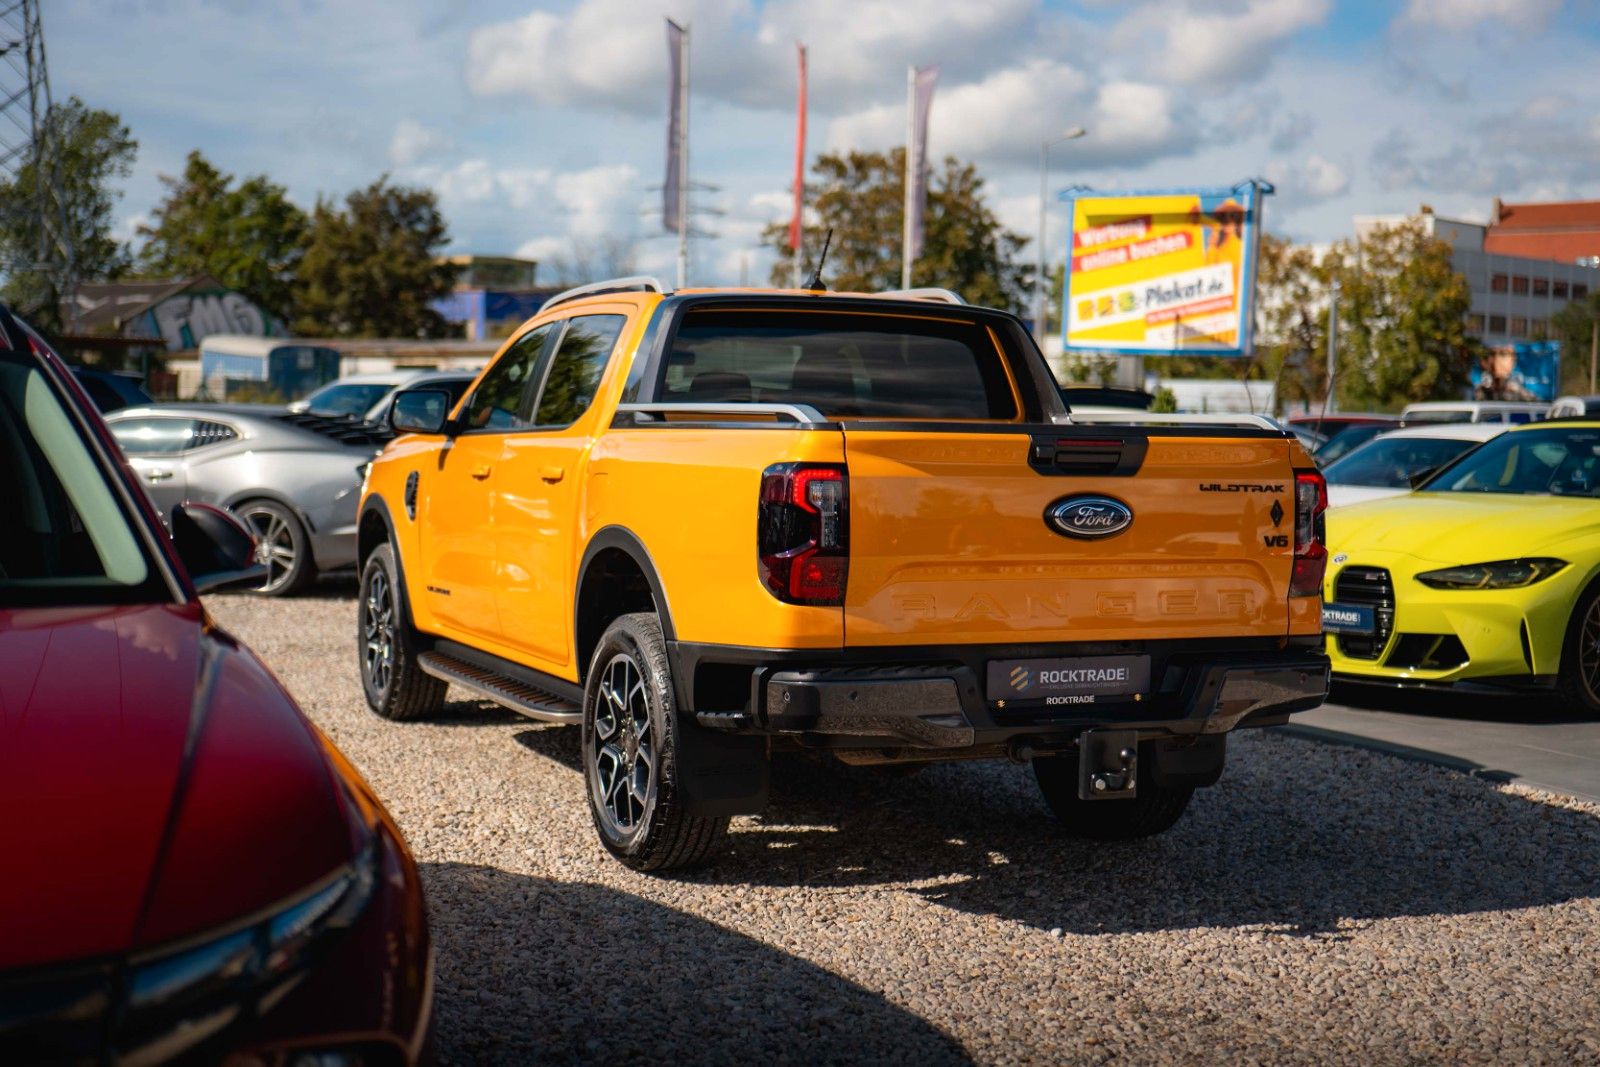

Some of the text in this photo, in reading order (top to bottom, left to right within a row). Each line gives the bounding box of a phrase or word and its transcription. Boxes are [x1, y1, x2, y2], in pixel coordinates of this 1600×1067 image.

[1199, 483, 1285, 493] WILDTRAK
[1074, 506, 1115, 526] Ford
[1263, 535, 1289, 548] V6
[893, 588, 1255, 621] RANGER
[1039, 668, 1125, 683] ROCKTRADE
[1046, 695, 1095, 705] ROCKTRADE
